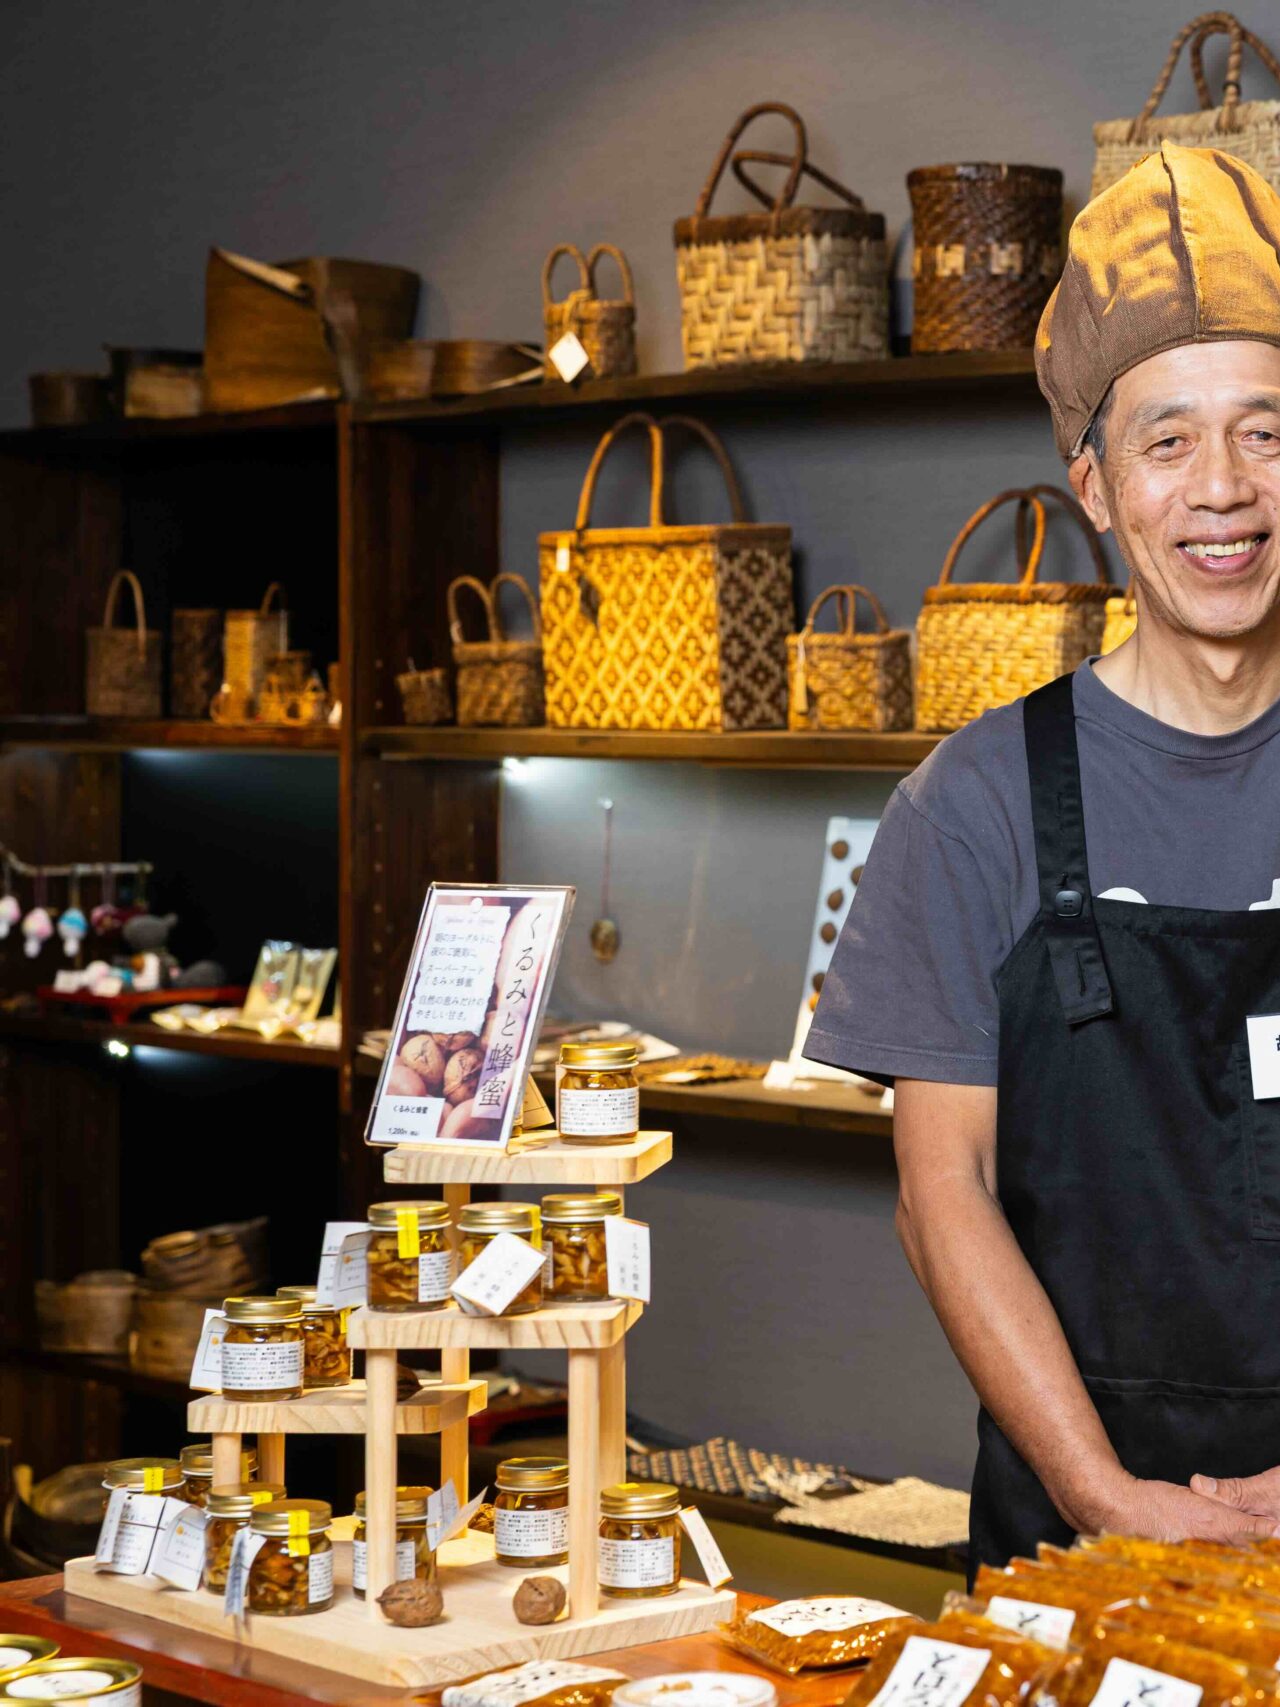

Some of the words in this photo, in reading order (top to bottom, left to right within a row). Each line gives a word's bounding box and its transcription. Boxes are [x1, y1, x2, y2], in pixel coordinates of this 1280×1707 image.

[478, 912, 541, 1107] くるみと蜂蜜
